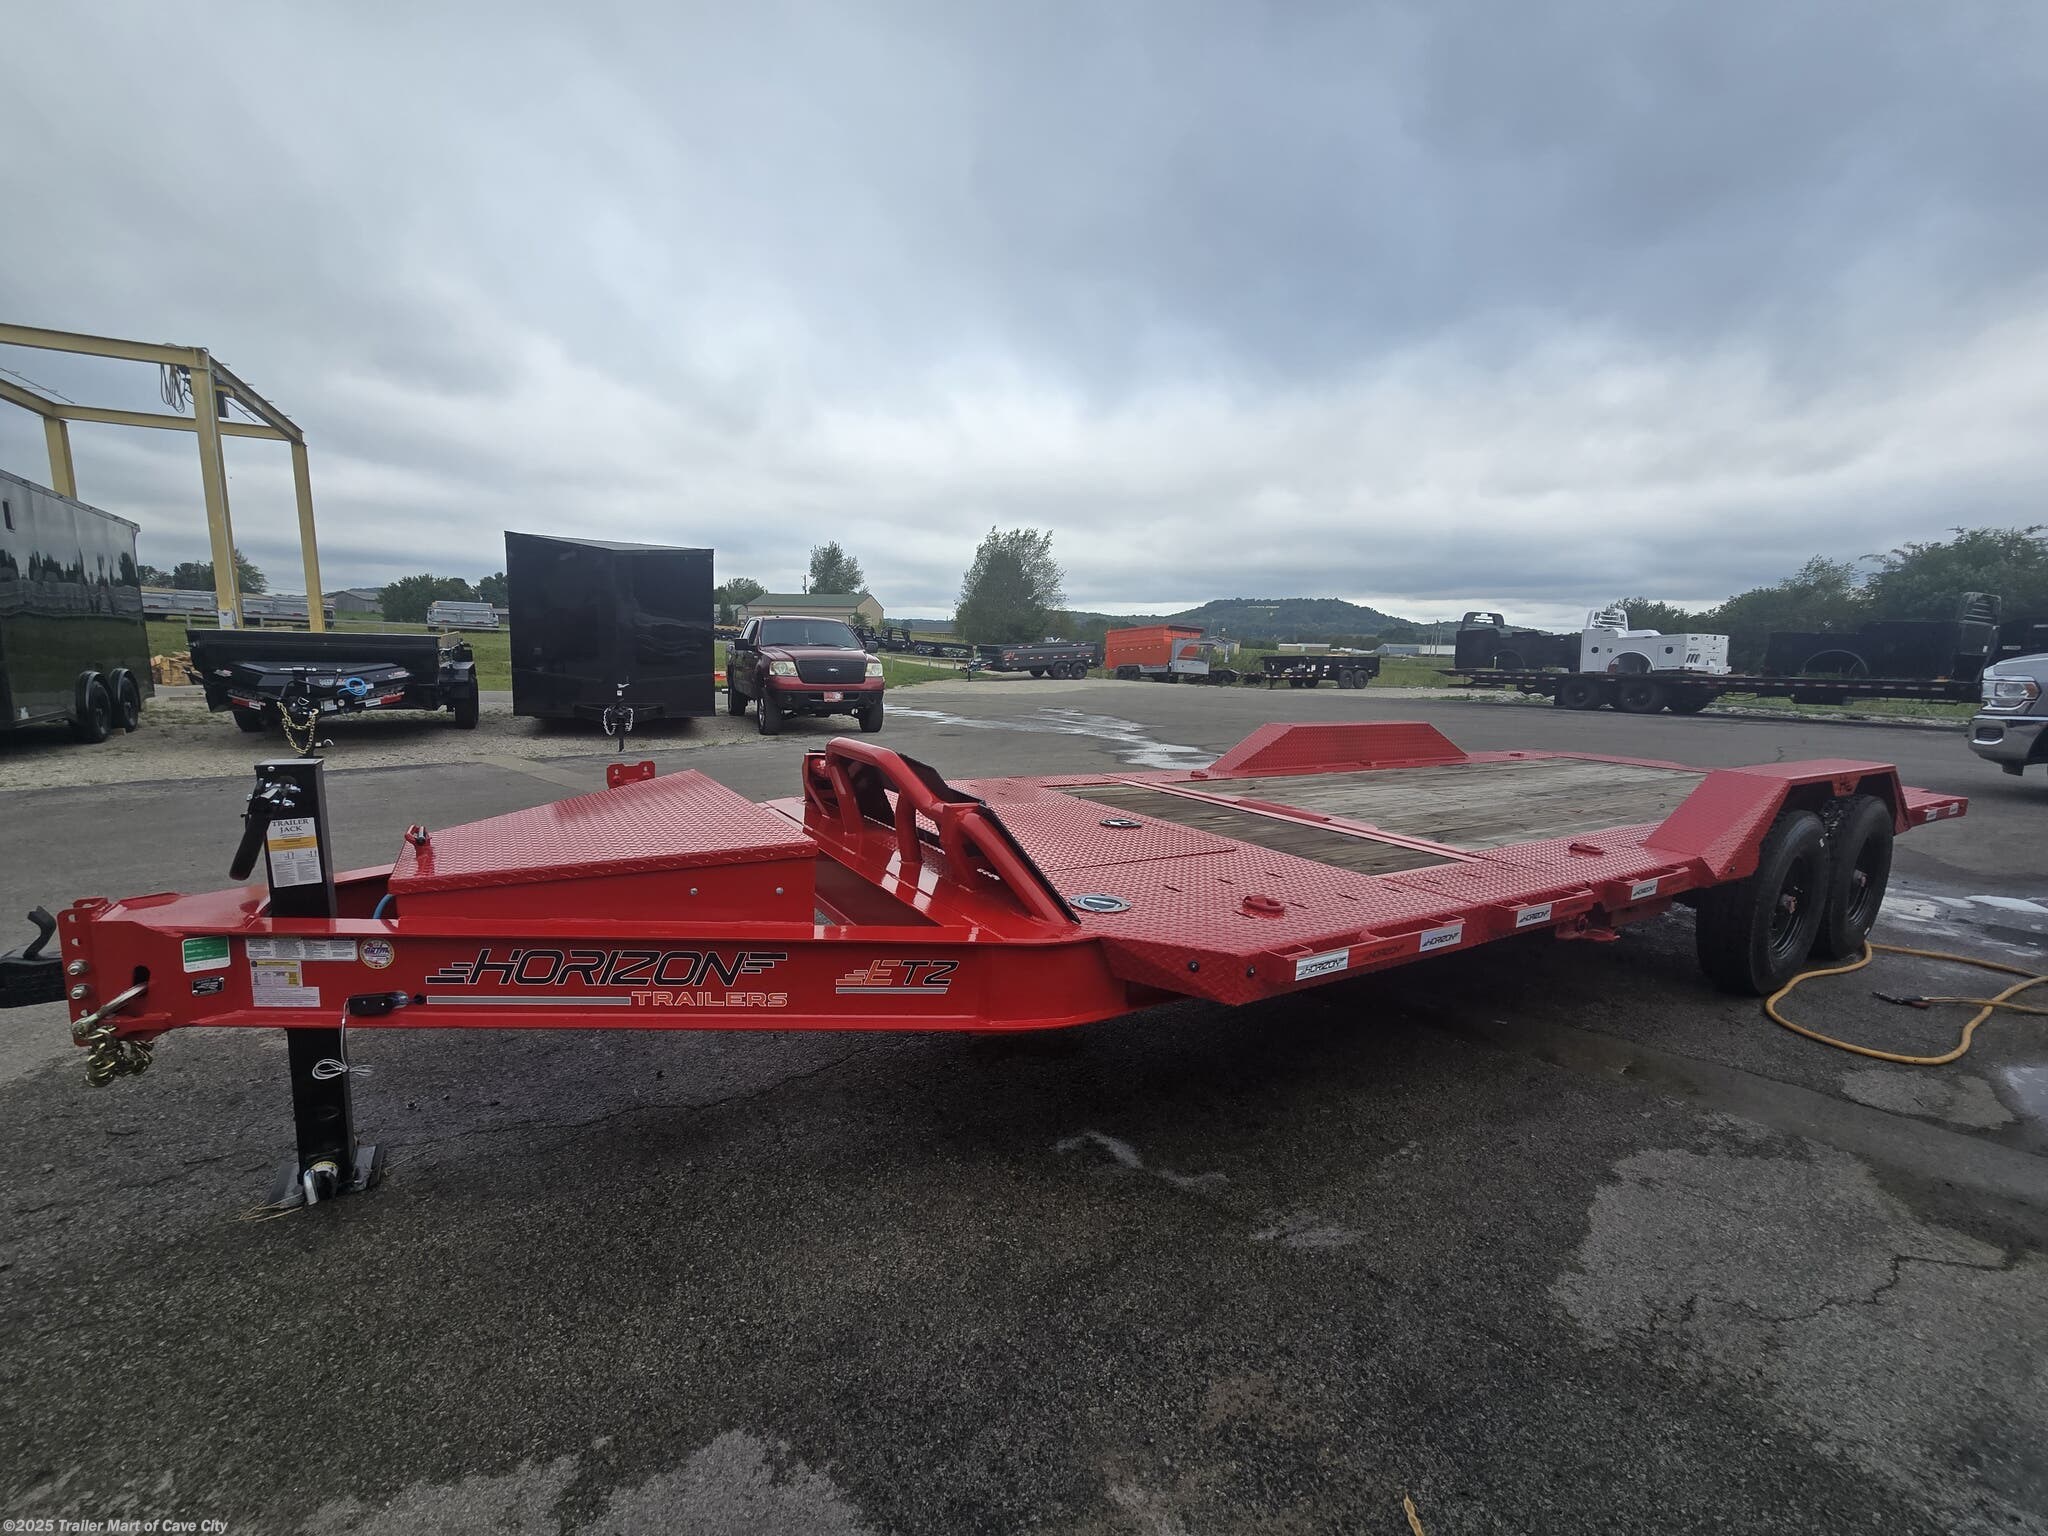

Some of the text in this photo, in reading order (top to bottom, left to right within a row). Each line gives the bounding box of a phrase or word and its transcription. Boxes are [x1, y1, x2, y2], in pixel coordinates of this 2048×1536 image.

[271, 818, 310, 827] TRAILER
[280, 825, 303, 834] JACK
[466, 949, 750, 986] HORIZON
[1300, 957, 1346, 976] HORIZON
[630, 991, 788, 1007] TRAILERS
